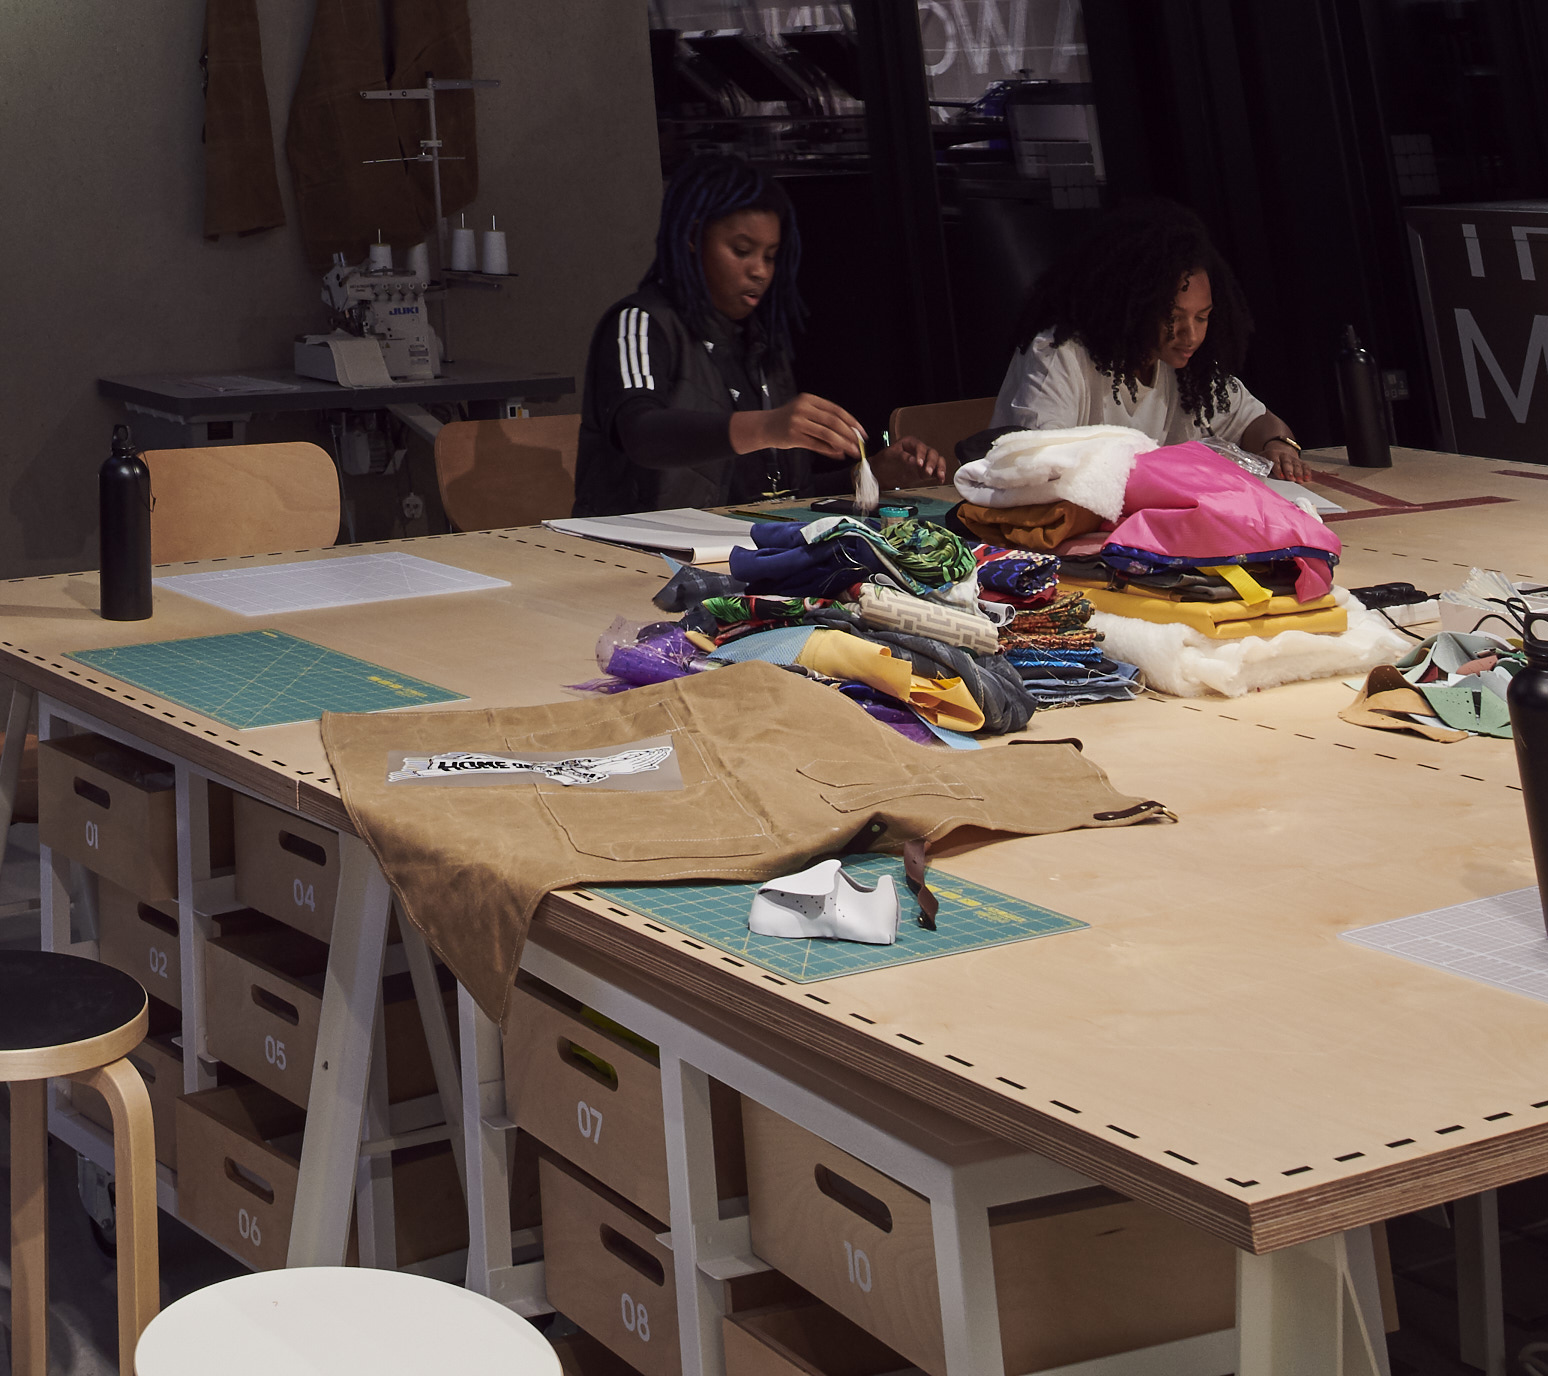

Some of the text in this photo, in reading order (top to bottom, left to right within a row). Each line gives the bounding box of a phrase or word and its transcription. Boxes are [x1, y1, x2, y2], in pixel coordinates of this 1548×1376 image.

[389, 306, 419, 316] JUKI
[437, 761, 511, 773] HOME
[86, 821, 98, 849] 01
[294, 879, 315, 912] 04
[150, 947, 167, 978] 02
[265, 1035, 286, 1070] 05
[578, 1101, 602, 1144] 07
[239, 1209, 261, 1246] 06
[843, 1240, 871, 1292] 10
[621, 1293, 650, 1341] 08
